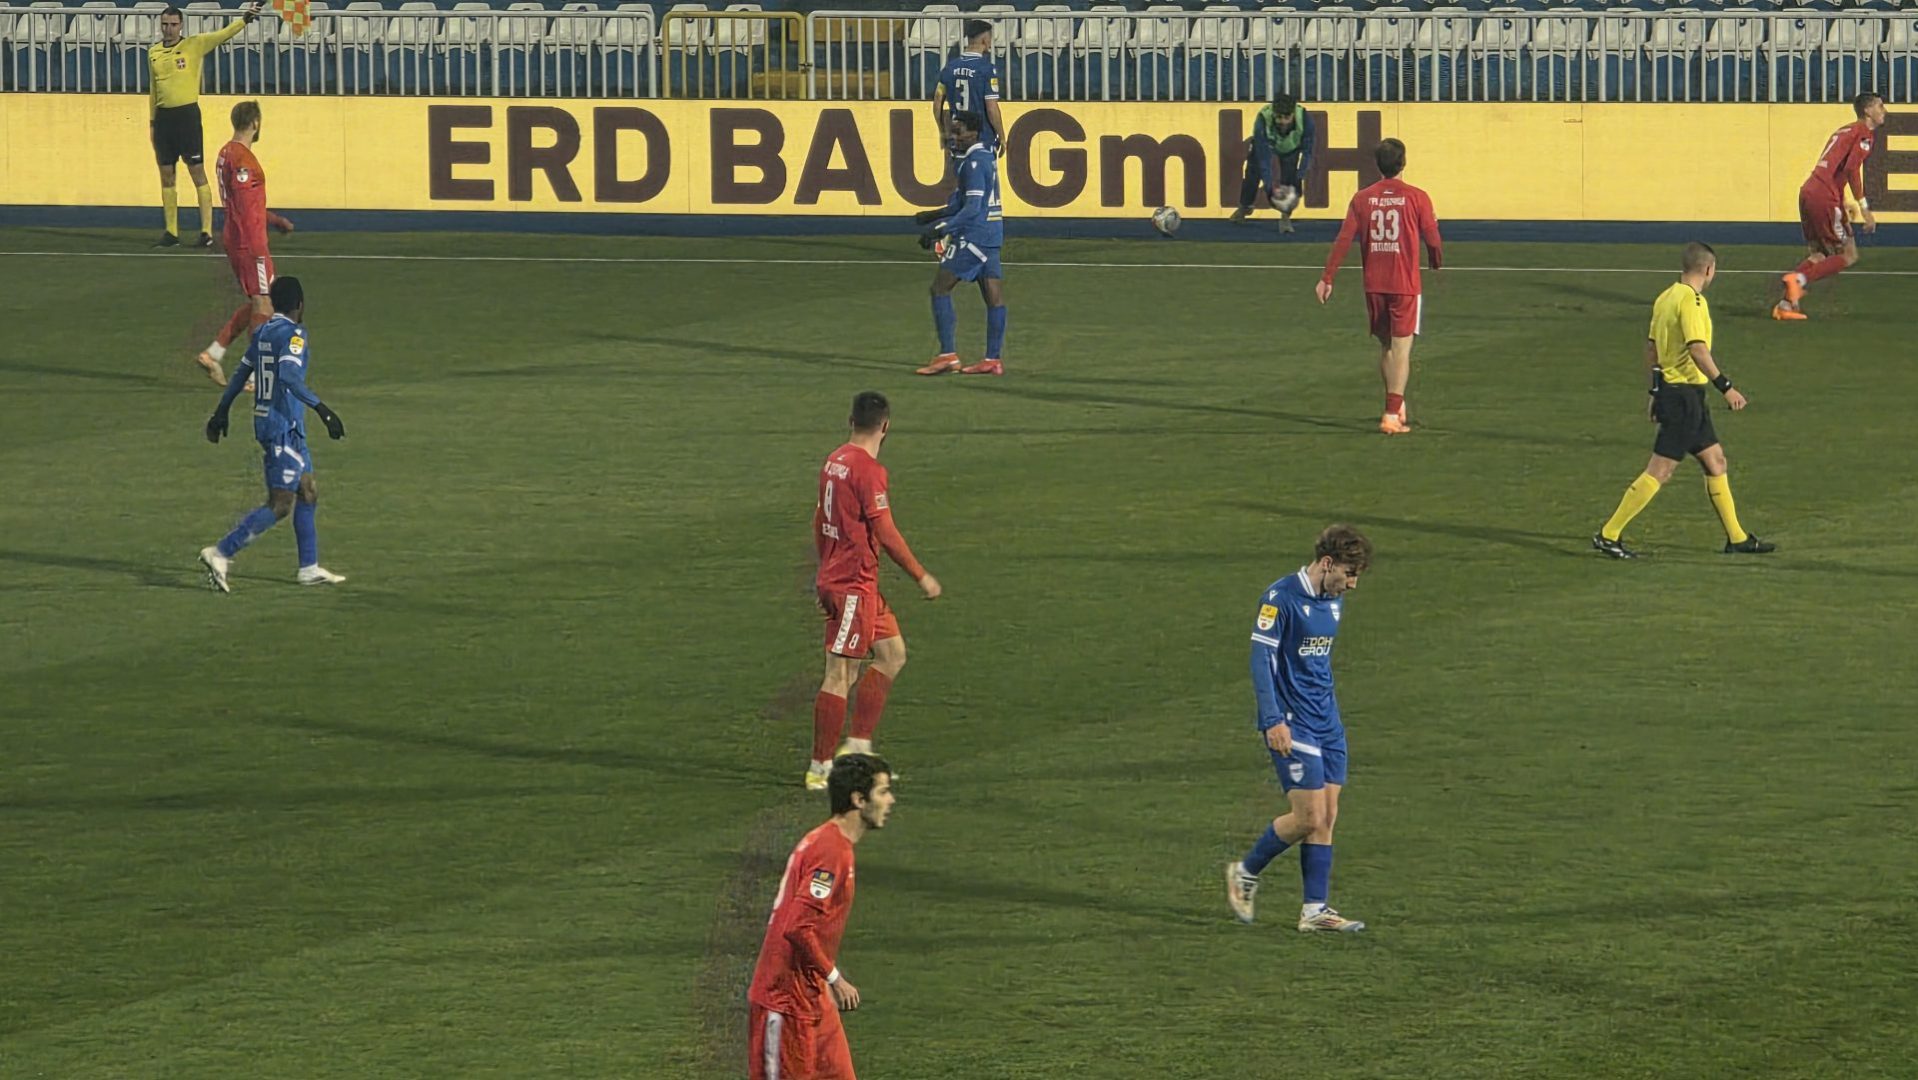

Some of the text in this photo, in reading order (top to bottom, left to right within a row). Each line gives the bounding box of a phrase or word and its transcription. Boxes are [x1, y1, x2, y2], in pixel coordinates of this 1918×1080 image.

[955, 78, 970, 111] 3
[428, 104, 671, 203] ERD
[710, 107, 959, 207] BAU
[1370, 209, 1400, 241] 33
[258, 355, 275, 400] 16
[824, 480, 833, 522] 8
[849, 633, 860, 650] 8
